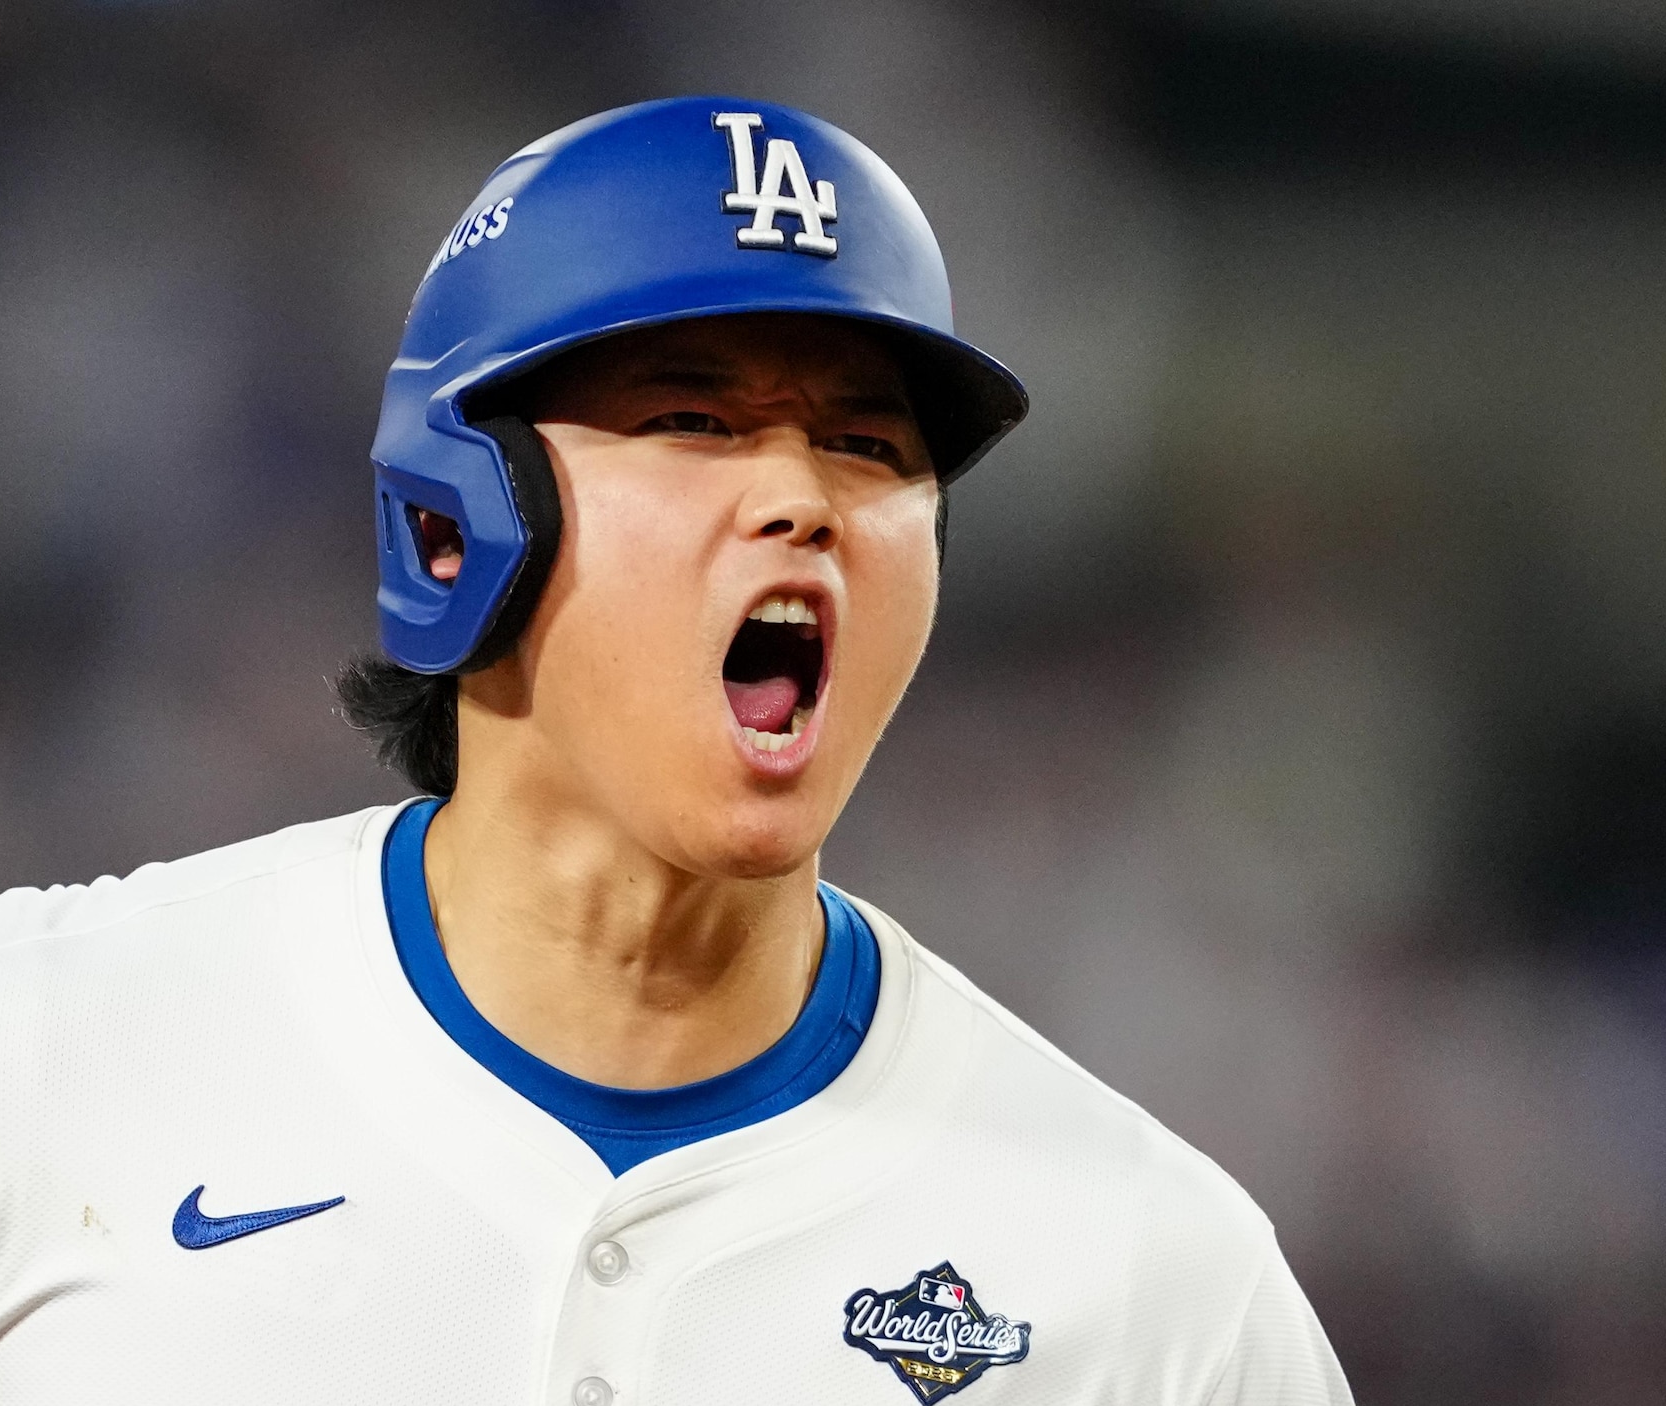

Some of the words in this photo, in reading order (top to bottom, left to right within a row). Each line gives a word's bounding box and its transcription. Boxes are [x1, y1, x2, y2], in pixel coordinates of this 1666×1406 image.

[711, 111, 838, 257] LA
[850, 1295, 949, 1343] World
[927, 1312, 1023, 1364] Series
